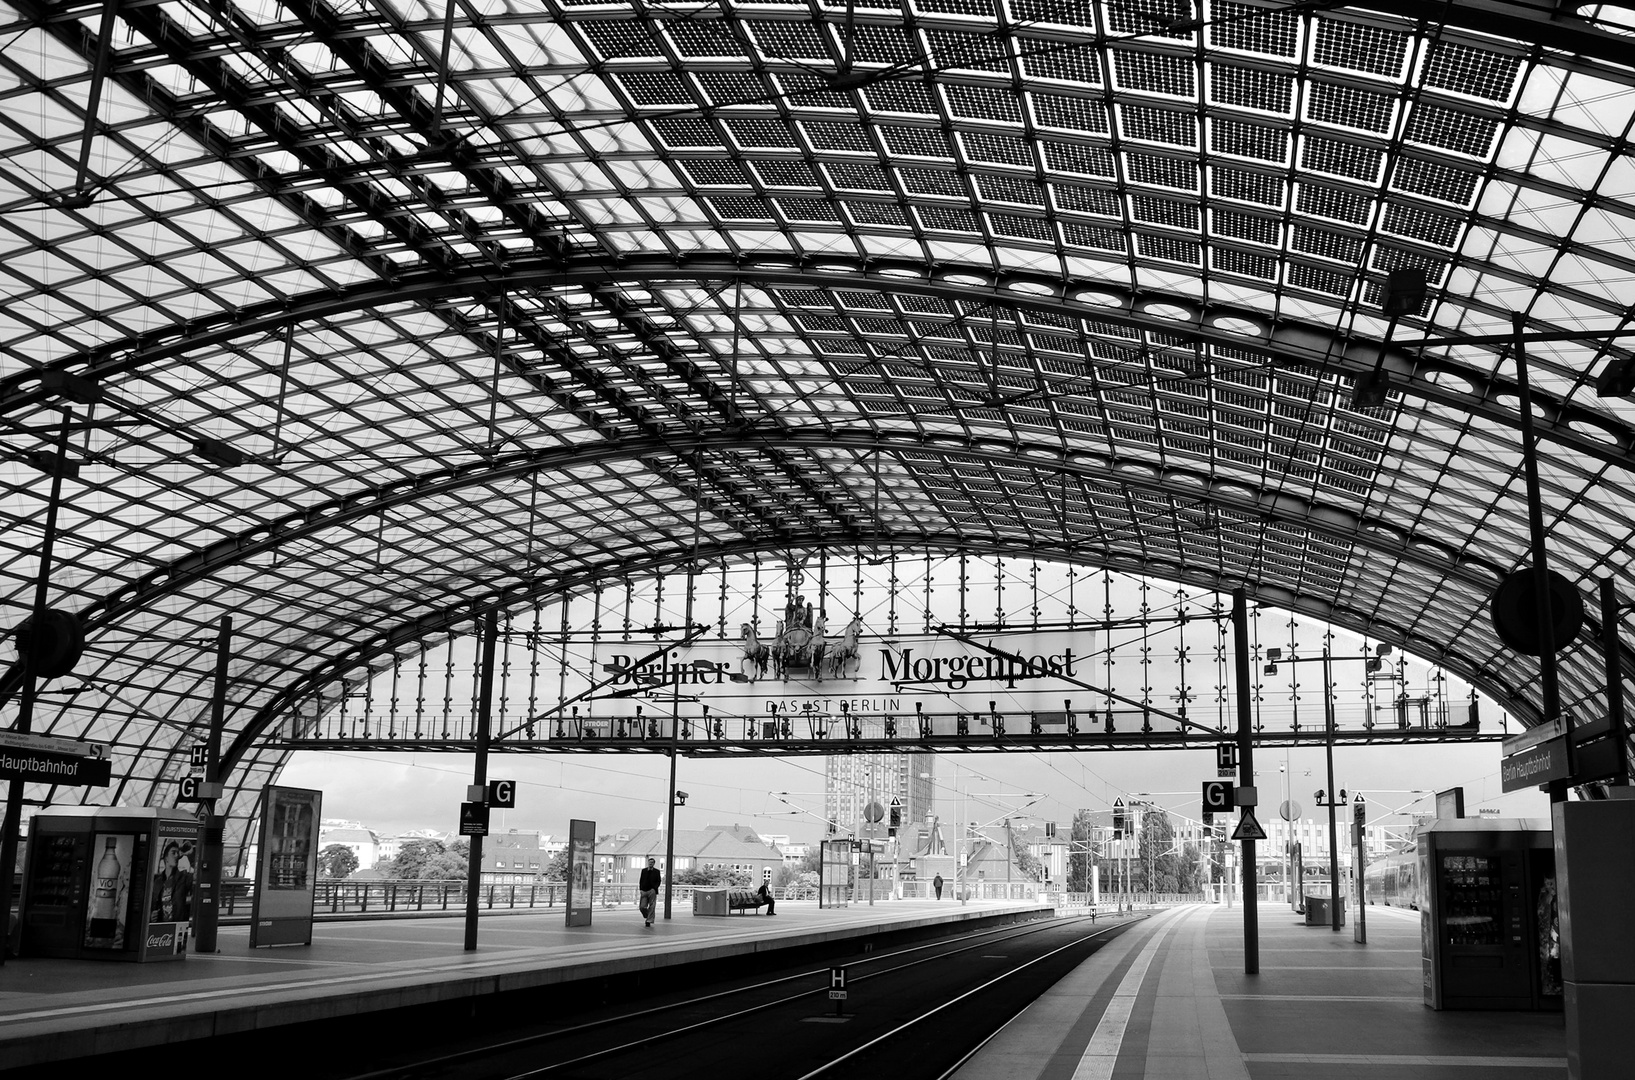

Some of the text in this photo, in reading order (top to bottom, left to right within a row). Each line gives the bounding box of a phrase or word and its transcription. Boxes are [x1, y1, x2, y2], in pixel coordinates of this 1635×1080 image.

[878, 648, 1077, 690] Morgenpost
[766, 700, 797, 712] DAS
[840, 699, 900, 712] BERLIN
[192, 748, 202, 763] H
[1220, 747, 1232, 765] H
[1516, 750, 1551, 780] Hauptbahnhof
[182, 778, 194, 798] G
[497, 781, 511, 802] G
[1207, 782, 1224, 806] G
[832, 969, 844, 987] H
